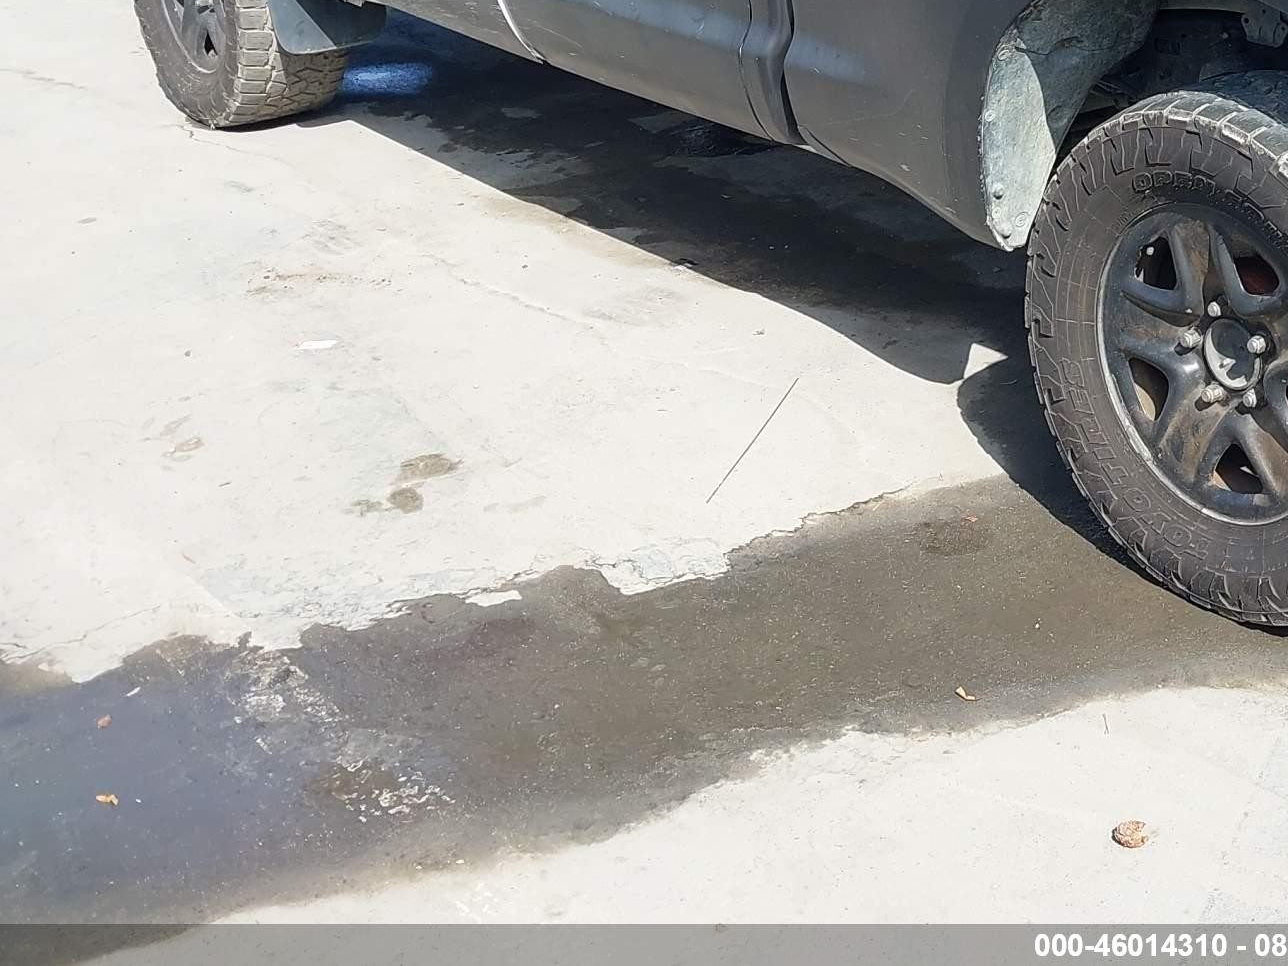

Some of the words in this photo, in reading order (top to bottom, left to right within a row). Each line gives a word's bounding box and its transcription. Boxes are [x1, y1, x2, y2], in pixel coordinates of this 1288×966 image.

[1132, 170, 1216, 197] OPEN
[1059, 357, 1129, 485] TIRES
[1121, 487, 1209, 560] TOYO
